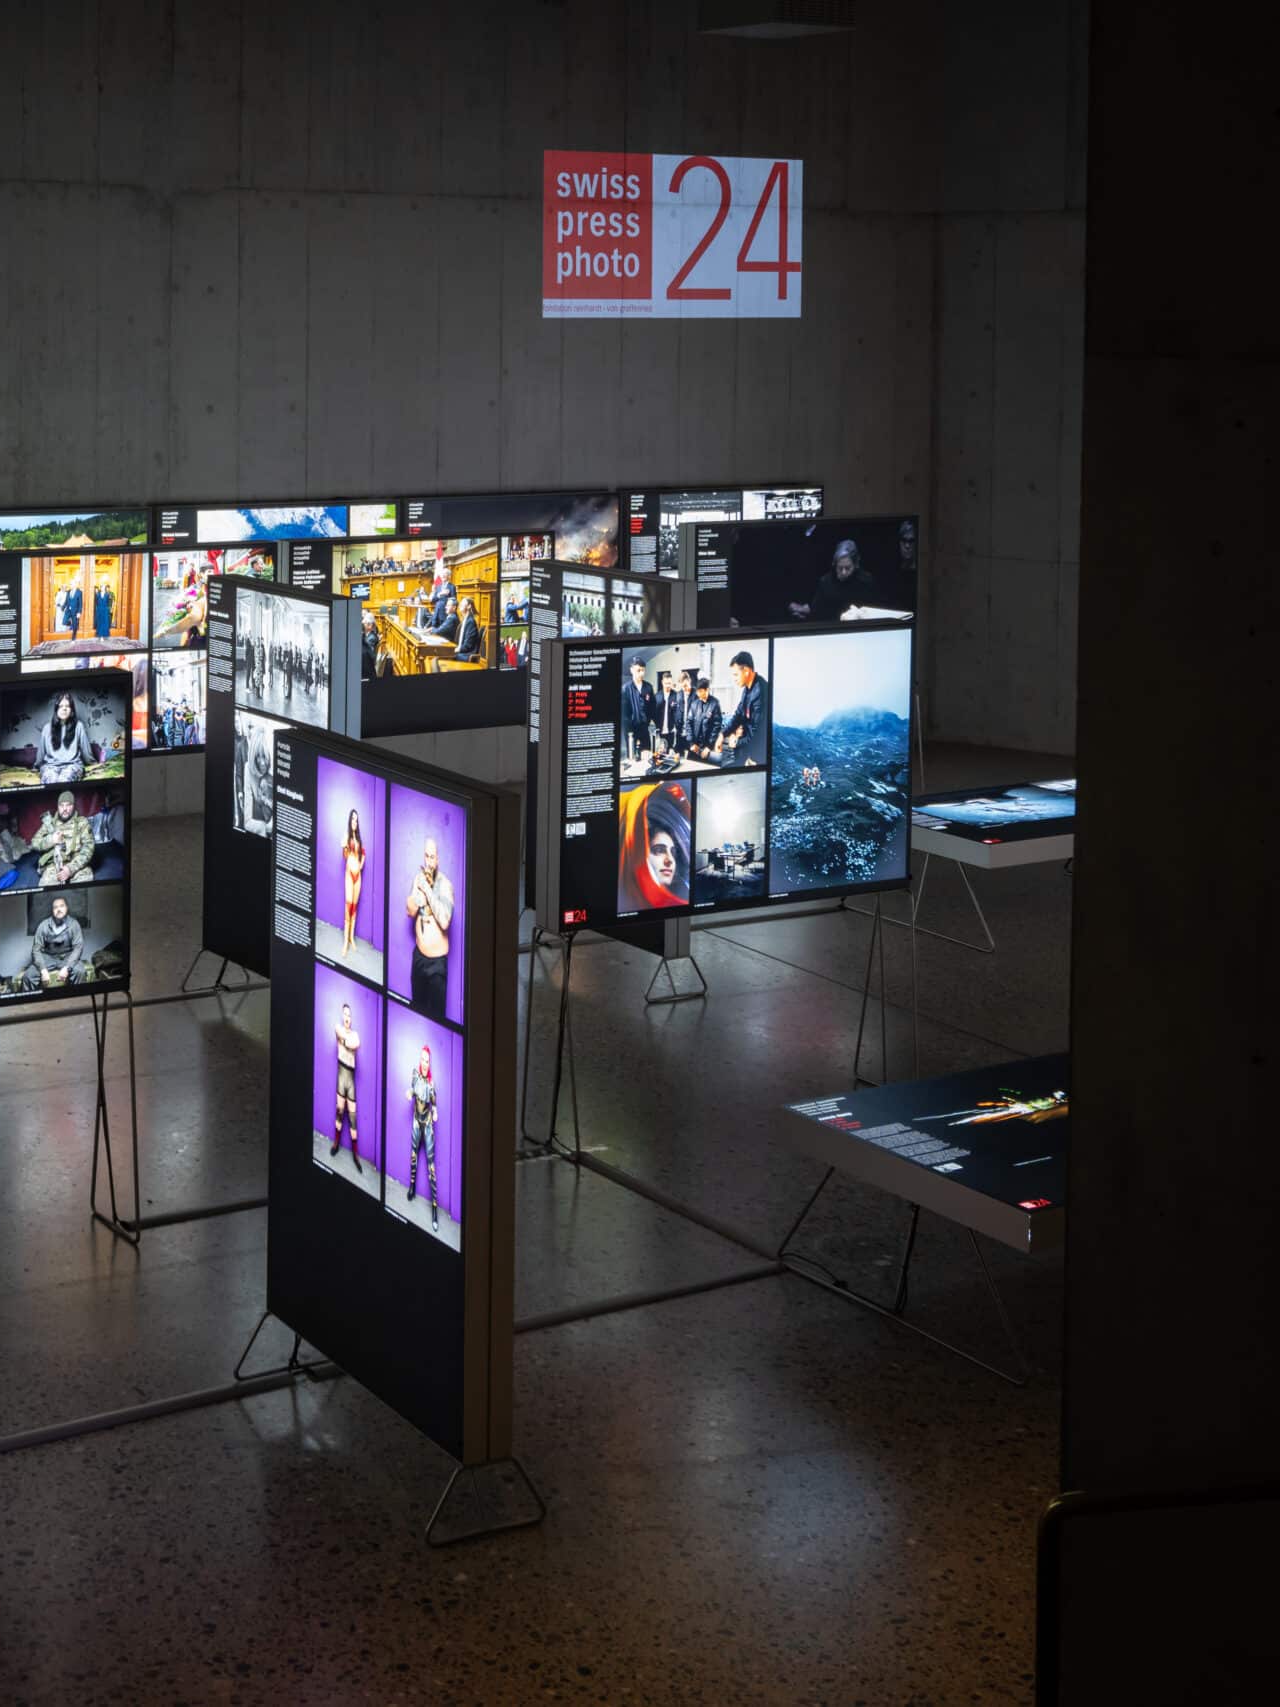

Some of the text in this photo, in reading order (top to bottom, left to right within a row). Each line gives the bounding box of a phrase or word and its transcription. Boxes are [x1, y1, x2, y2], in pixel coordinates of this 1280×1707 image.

[556, 167, 641, 200] swiss
[556, 210, 641, 244] press
[666, 155, 801, 301] 24
[556, 246, 640, 284] photo
